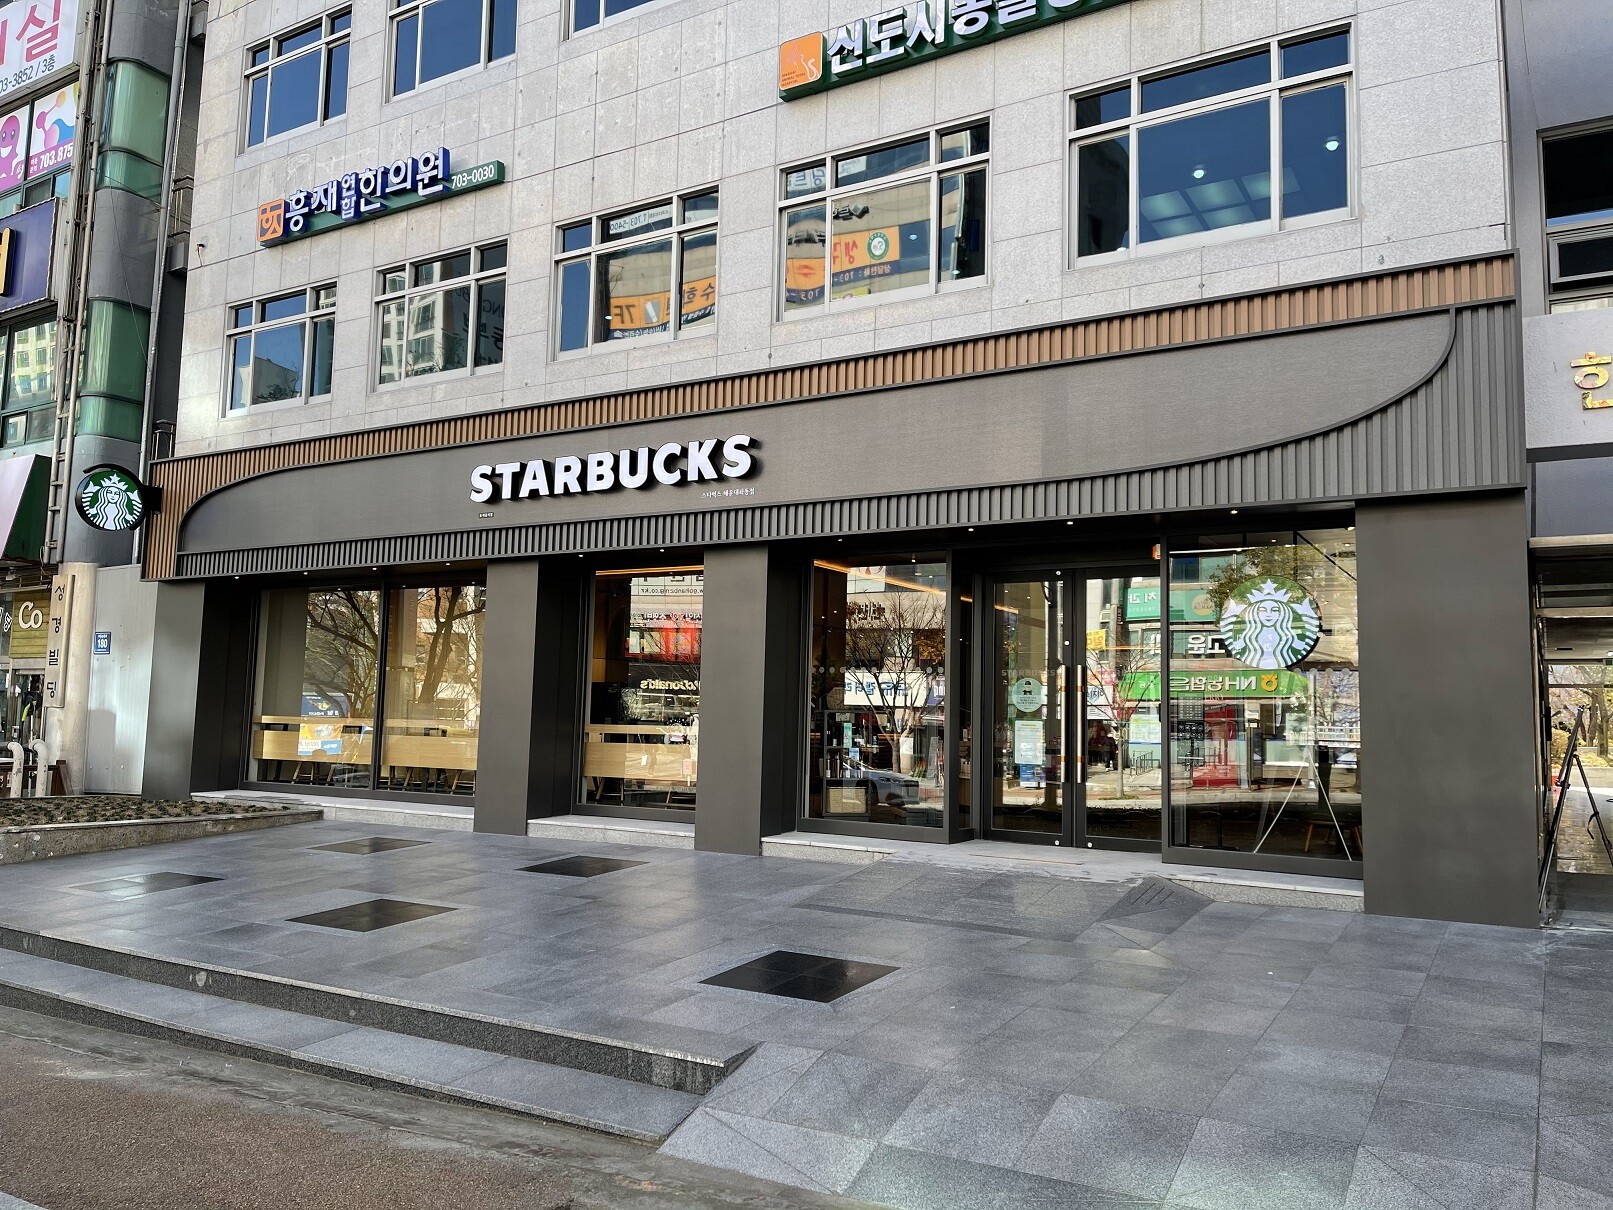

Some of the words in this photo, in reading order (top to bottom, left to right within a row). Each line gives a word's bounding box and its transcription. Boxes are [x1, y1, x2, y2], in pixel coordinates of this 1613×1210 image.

[827, 0, 1080, 73] 신도시동
[451, 164, 495, 189] 703-0030
[470, 434, 752, 503] STARBUCKS
[18, 601, 43, 629] Co
